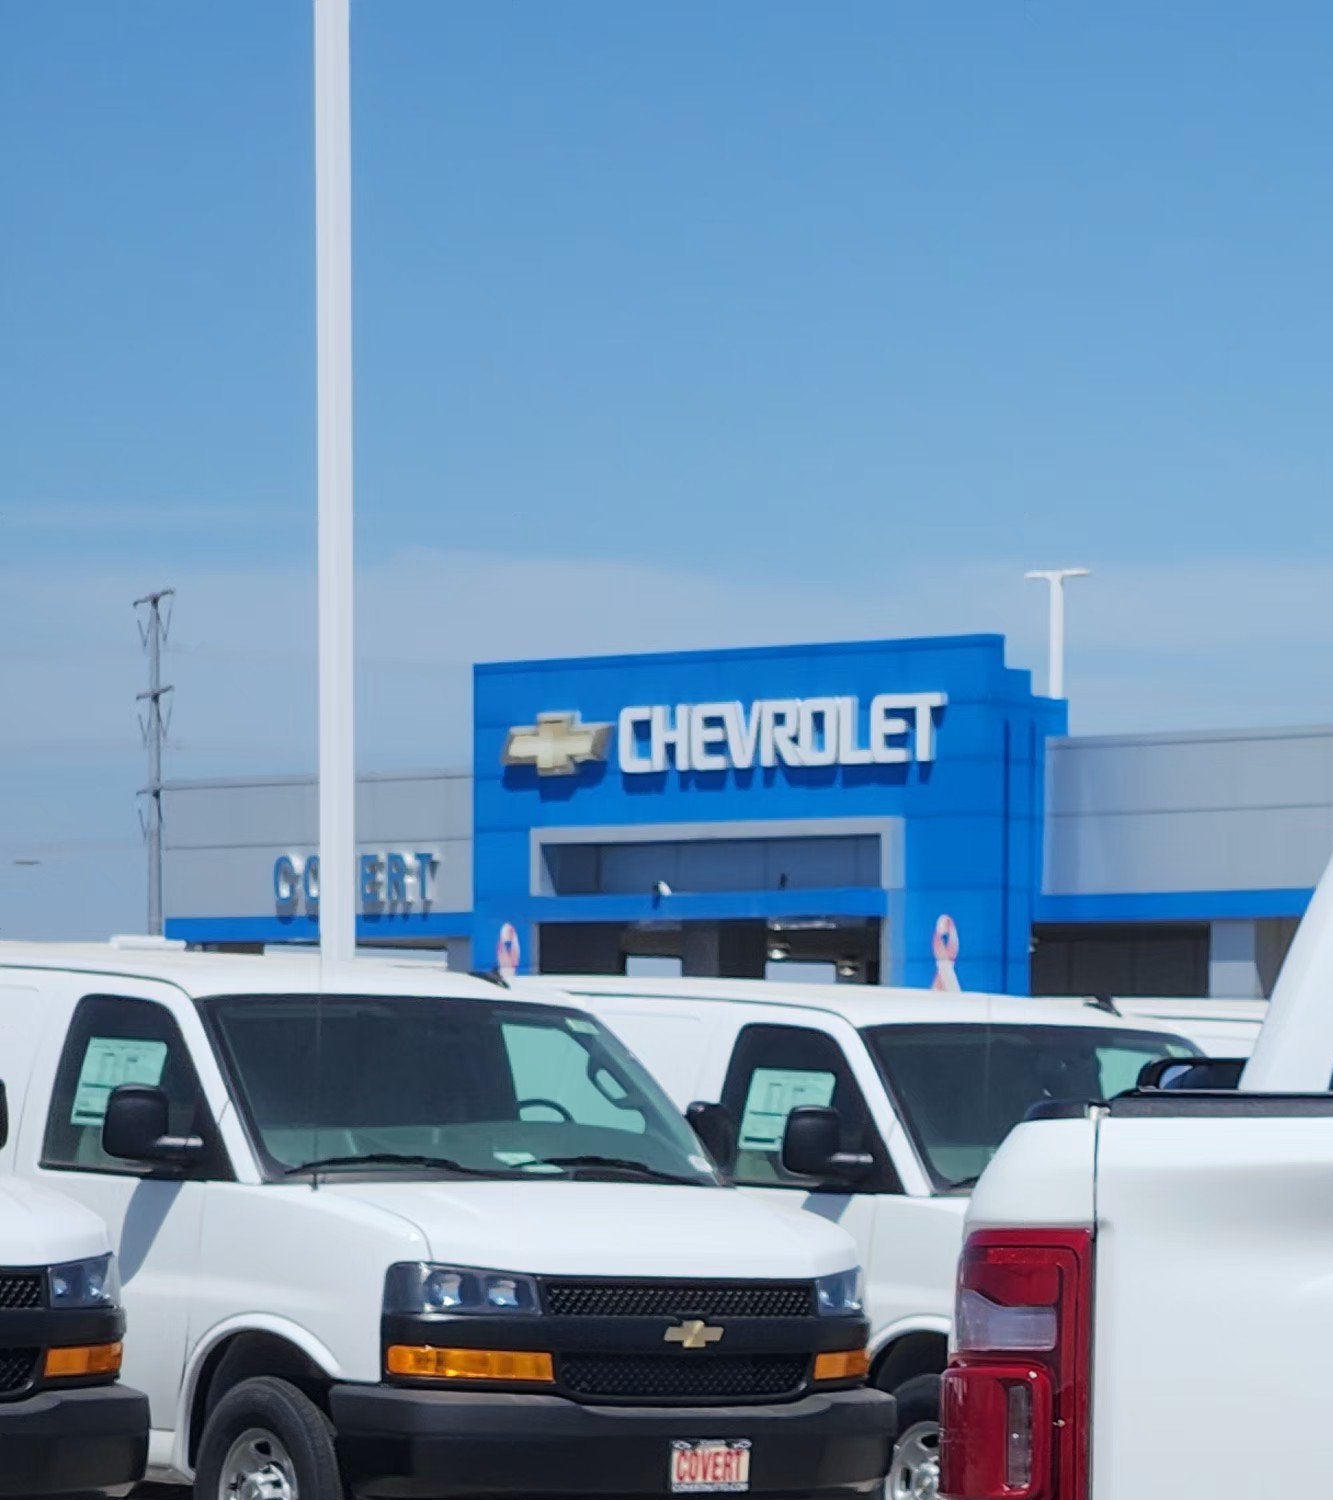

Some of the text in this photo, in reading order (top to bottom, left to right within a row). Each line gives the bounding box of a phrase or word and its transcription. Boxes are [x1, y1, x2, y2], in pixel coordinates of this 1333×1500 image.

[618, 691, 946, 773] CHEVROLET
[273, 852, 434, 902] COERT
[676, 1450, 742, 1481] COVERT
